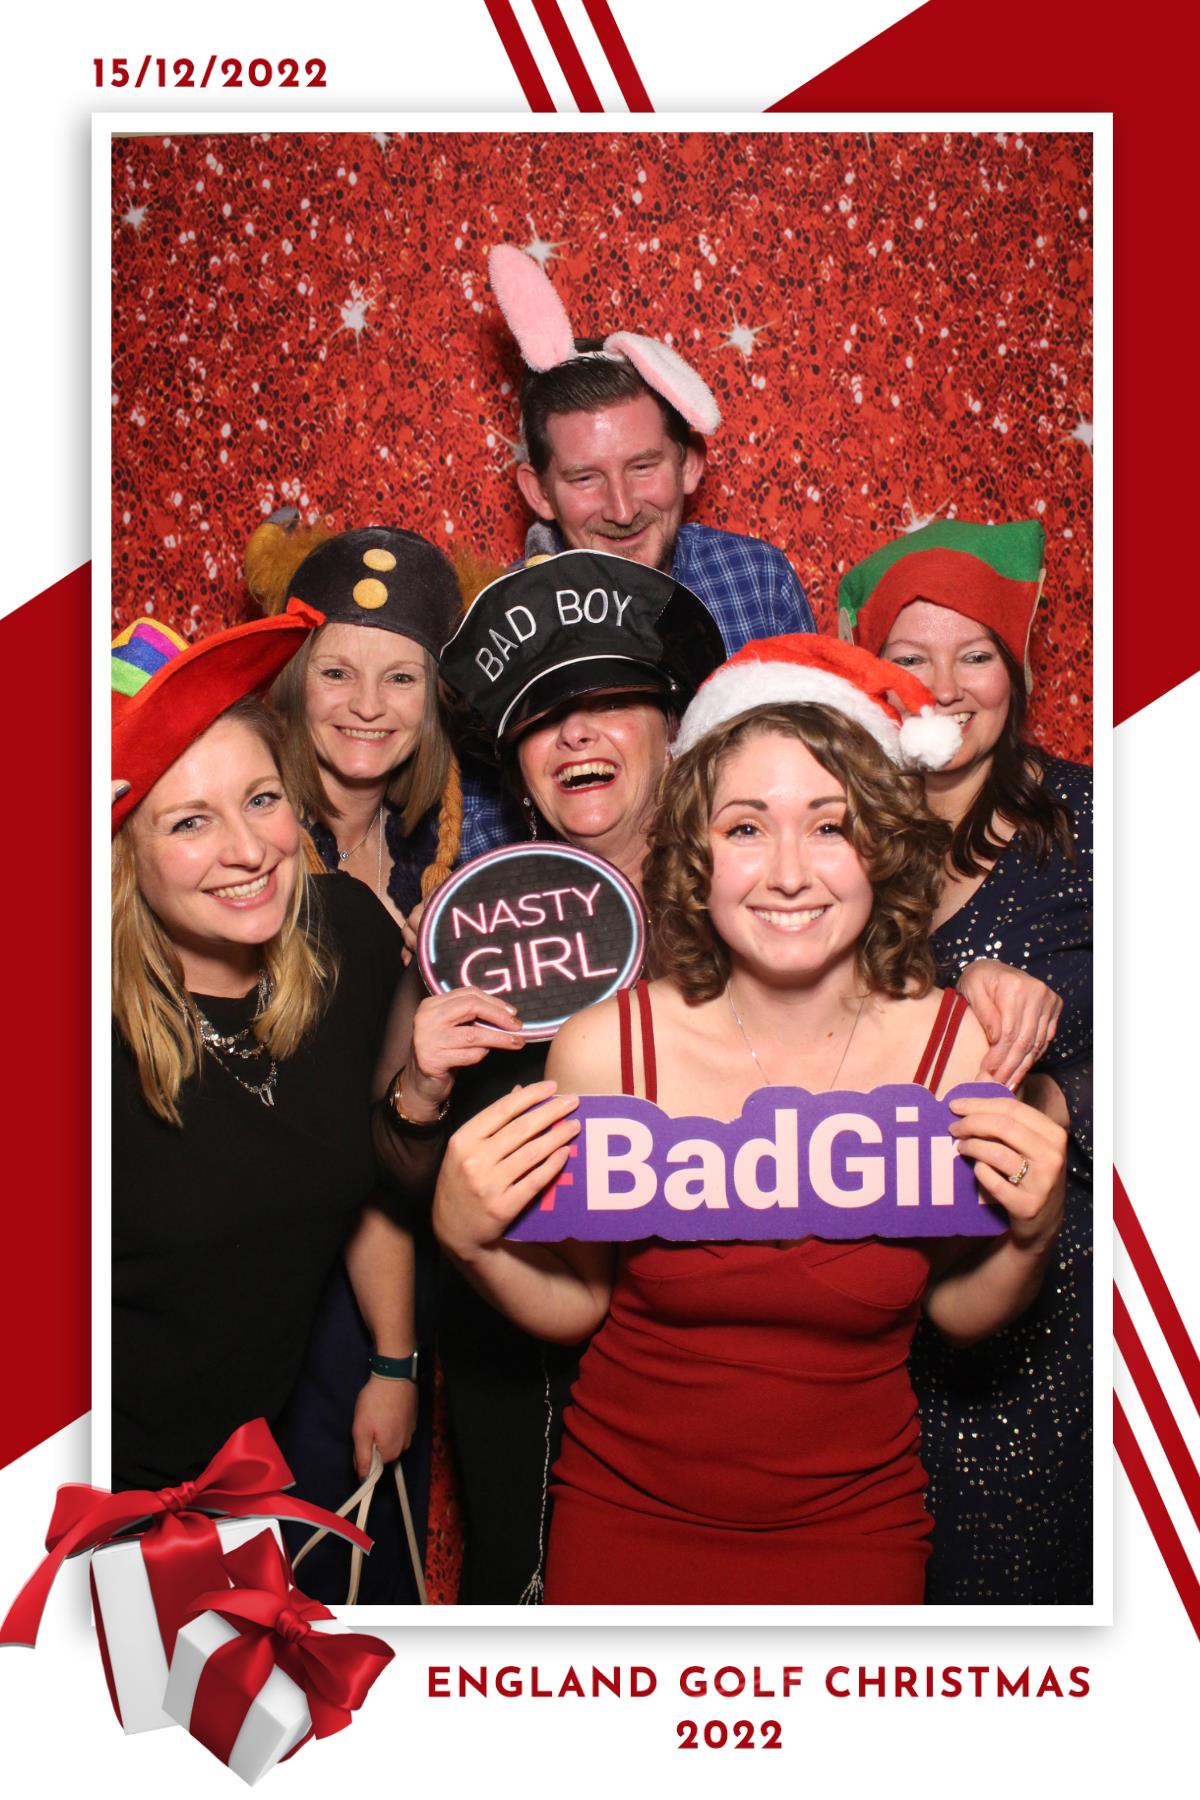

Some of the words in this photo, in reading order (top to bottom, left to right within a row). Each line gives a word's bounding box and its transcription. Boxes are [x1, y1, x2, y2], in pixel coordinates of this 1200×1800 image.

[474, 605, 537, 682] BAD
[555, 587, 633, 627] BOY
[452, 882, 601, 939] NASTY
[460, 931, 618, 995] GIRL
[539, 1106, 986, 1212] BadGir
